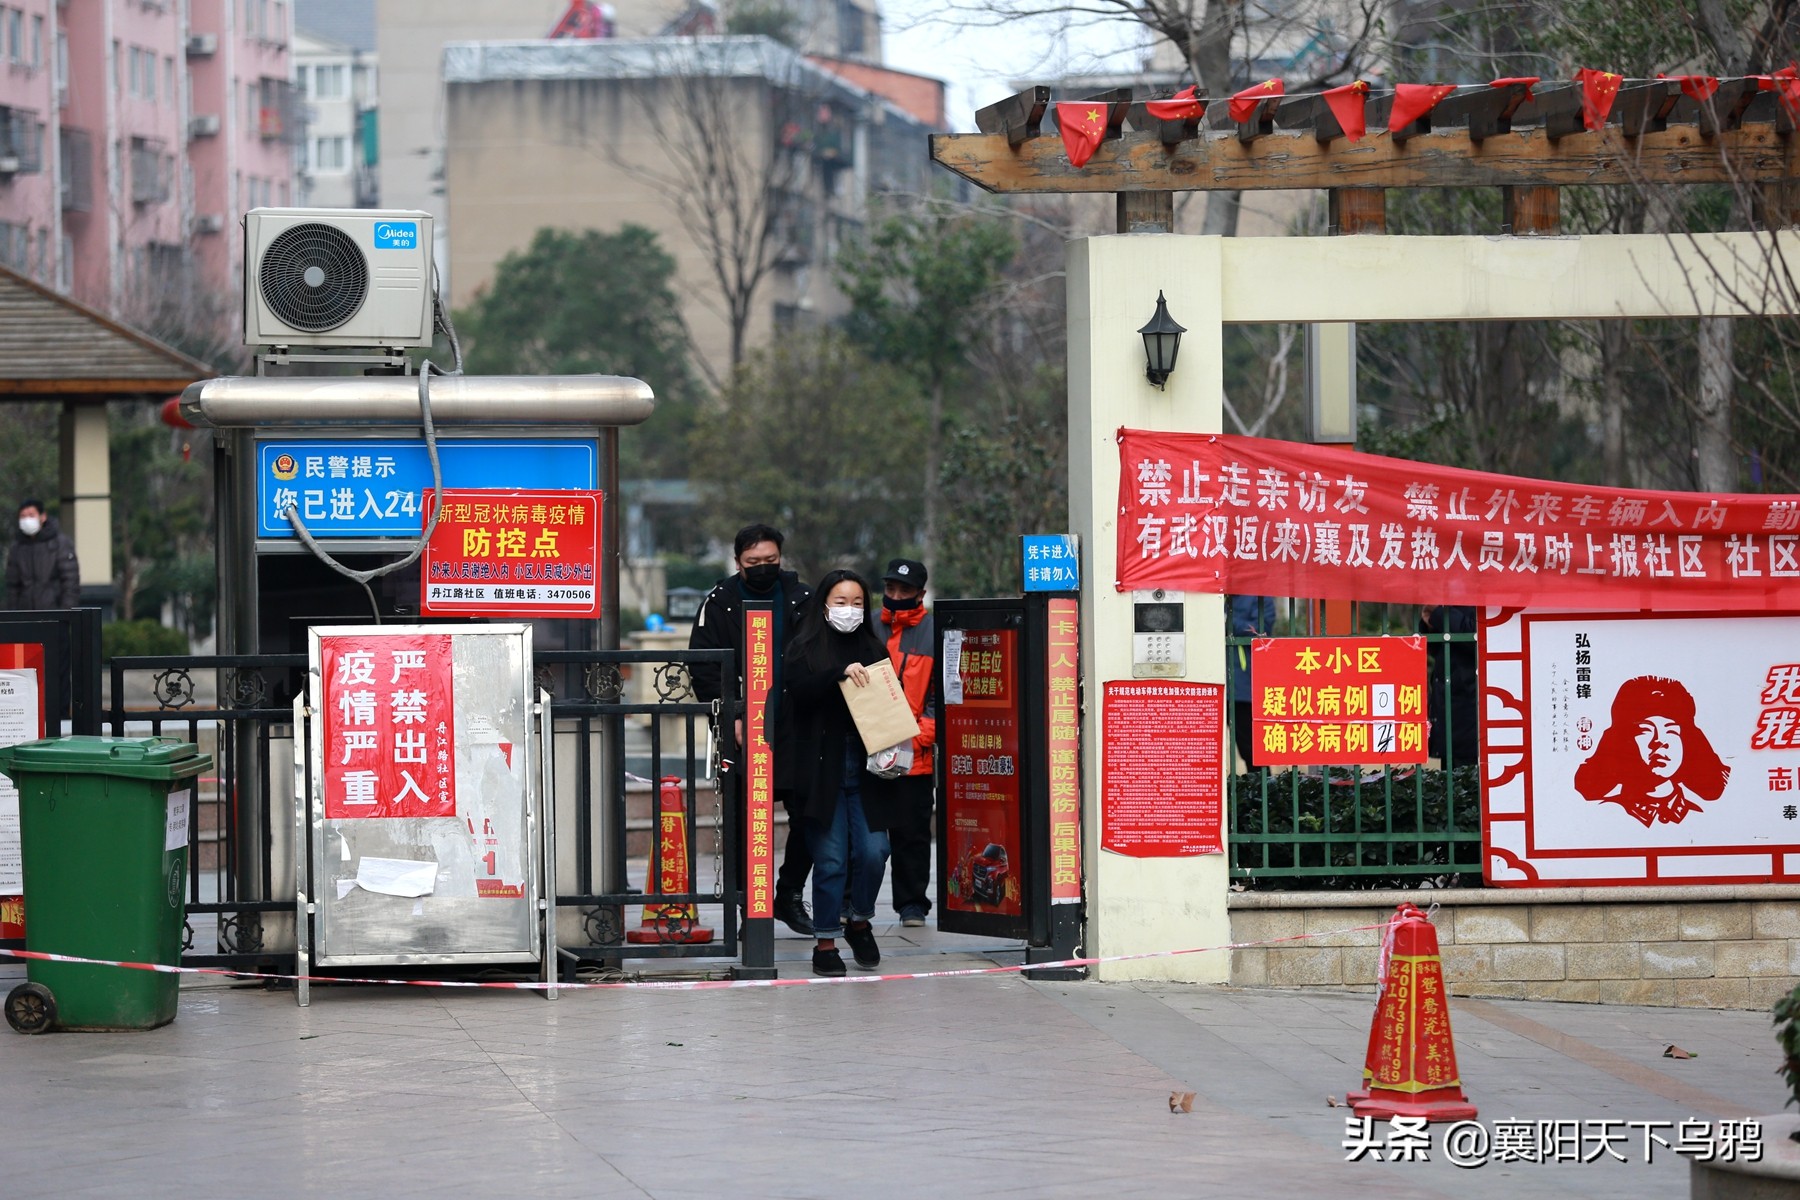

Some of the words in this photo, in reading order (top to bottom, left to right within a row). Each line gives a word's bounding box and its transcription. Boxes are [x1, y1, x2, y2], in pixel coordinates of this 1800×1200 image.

[379, 225, 414, 239] Midea
[392, 239, 410, 247] 美的
[305, 456, 396, 478] 民警提示
[273, 488, 422, 519] 您已进入24
[438, 503, 586, 526] 新型冠状病毒疫情
[1137, 459, 1370, 515] 禁止走亲访友
[1403, 482, 1727, 530] 禁止外来车辆入内
[463, 527, 560, 558] 防控点
[1028, 545, 1074, 560] 凭卡进入
[1136, 513, 1706, 578] 有武汉返(来)襄及发热人员及时上报社区
[1725, 534, 1800, 578] 社区
[431, 562, 509, 580] 外来人员谢绝入内
[513, 562, 593, 581] 小区人员减少外出
[431, 587, 485, 600] 丹江路社区
[1028, 567, 1075, 582] 非请勿入
[752, 617, 767, 691] 刷卡自动开门
[960, 651, 1002, 673] 尊品车位
[1051, 609, 1075, 669] 一卡一人
[1295, 646, 1382, 675] 本小区
[1575, 633, 1591, 699] 弘扬雷锋
[338, 650, 379, 805] 疫情严重
[390, 650, 430, 804] 严禁出入
[752, 701, 766, 747] 一人一卡
[1051, 676, 1076, 741] 禁止尾随
[1576, 716, 1593, 751] 精神
[435, 721, 449, 803] 丹江路社区宣
[752, 752, 768, 802] 禁止尾随
[1052, 749, 1076, 813] 谨防夹伤
[1768, 767, 1800, 791] 志
[752, 808, 767, 857] 谨防夹伤
[1783, 804, 1798, 821] 奉
[1053, 821, 1077, 885] 后果自负
[752, 863, 767, 913] 后果自负
[1391, 962, 1411, 1082] 4007361199
